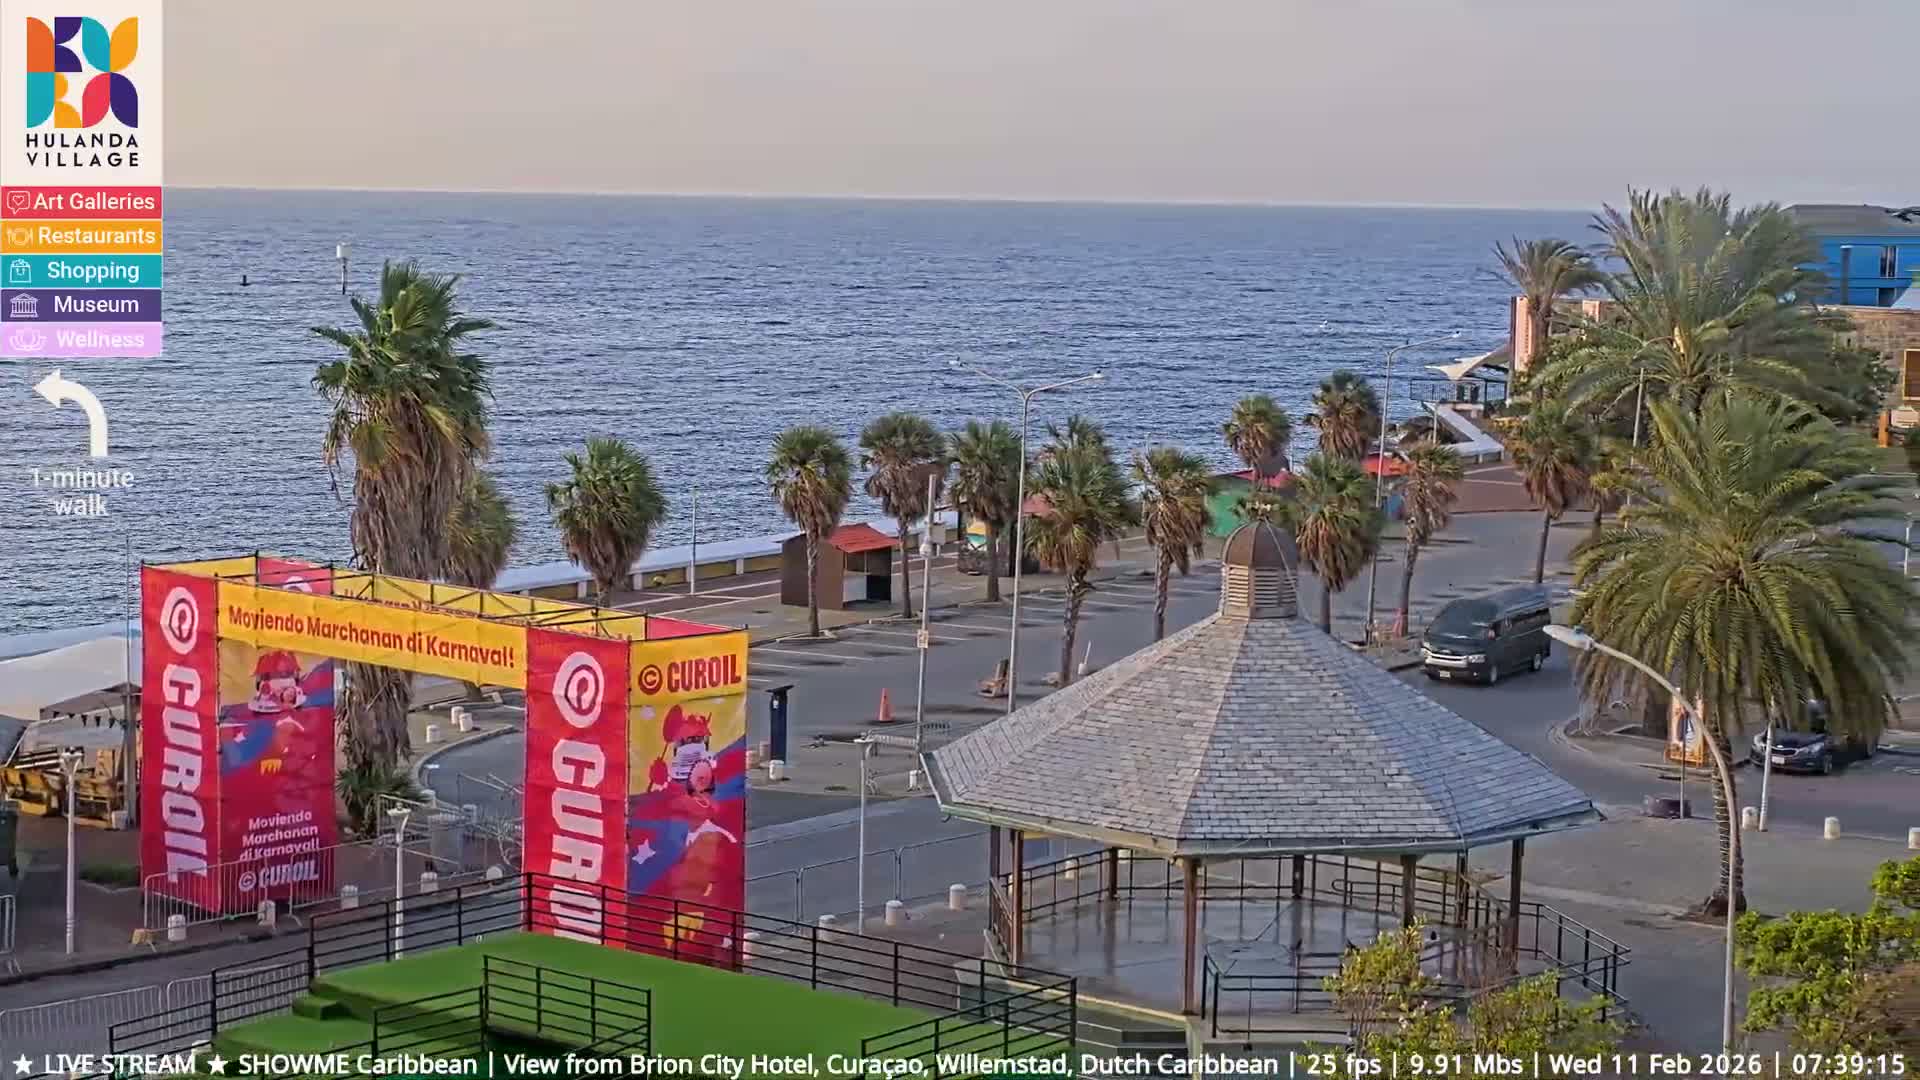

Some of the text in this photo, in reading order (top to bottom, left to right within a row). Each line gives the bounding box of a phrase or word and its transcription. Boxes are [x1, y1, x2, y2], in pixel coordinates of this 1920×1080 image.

[228, 605, 305, 634] Moviendo
[306, 616, 403, 651] Marchanan
[407, 632, 422, 654] di
[426, 635, 514, 668] Karnaval!
[666, 654, 742, 693] CUROIL
[162, 663, 208, 883] CUROIL
[241, 825, 319, 848] Marchanan
[248, 810, 313, 831] Moviendo
[239, 849, 253, 862] di
[550, 738, 606, 945] CURO
[258, 859, 320, 889] CUROIL
